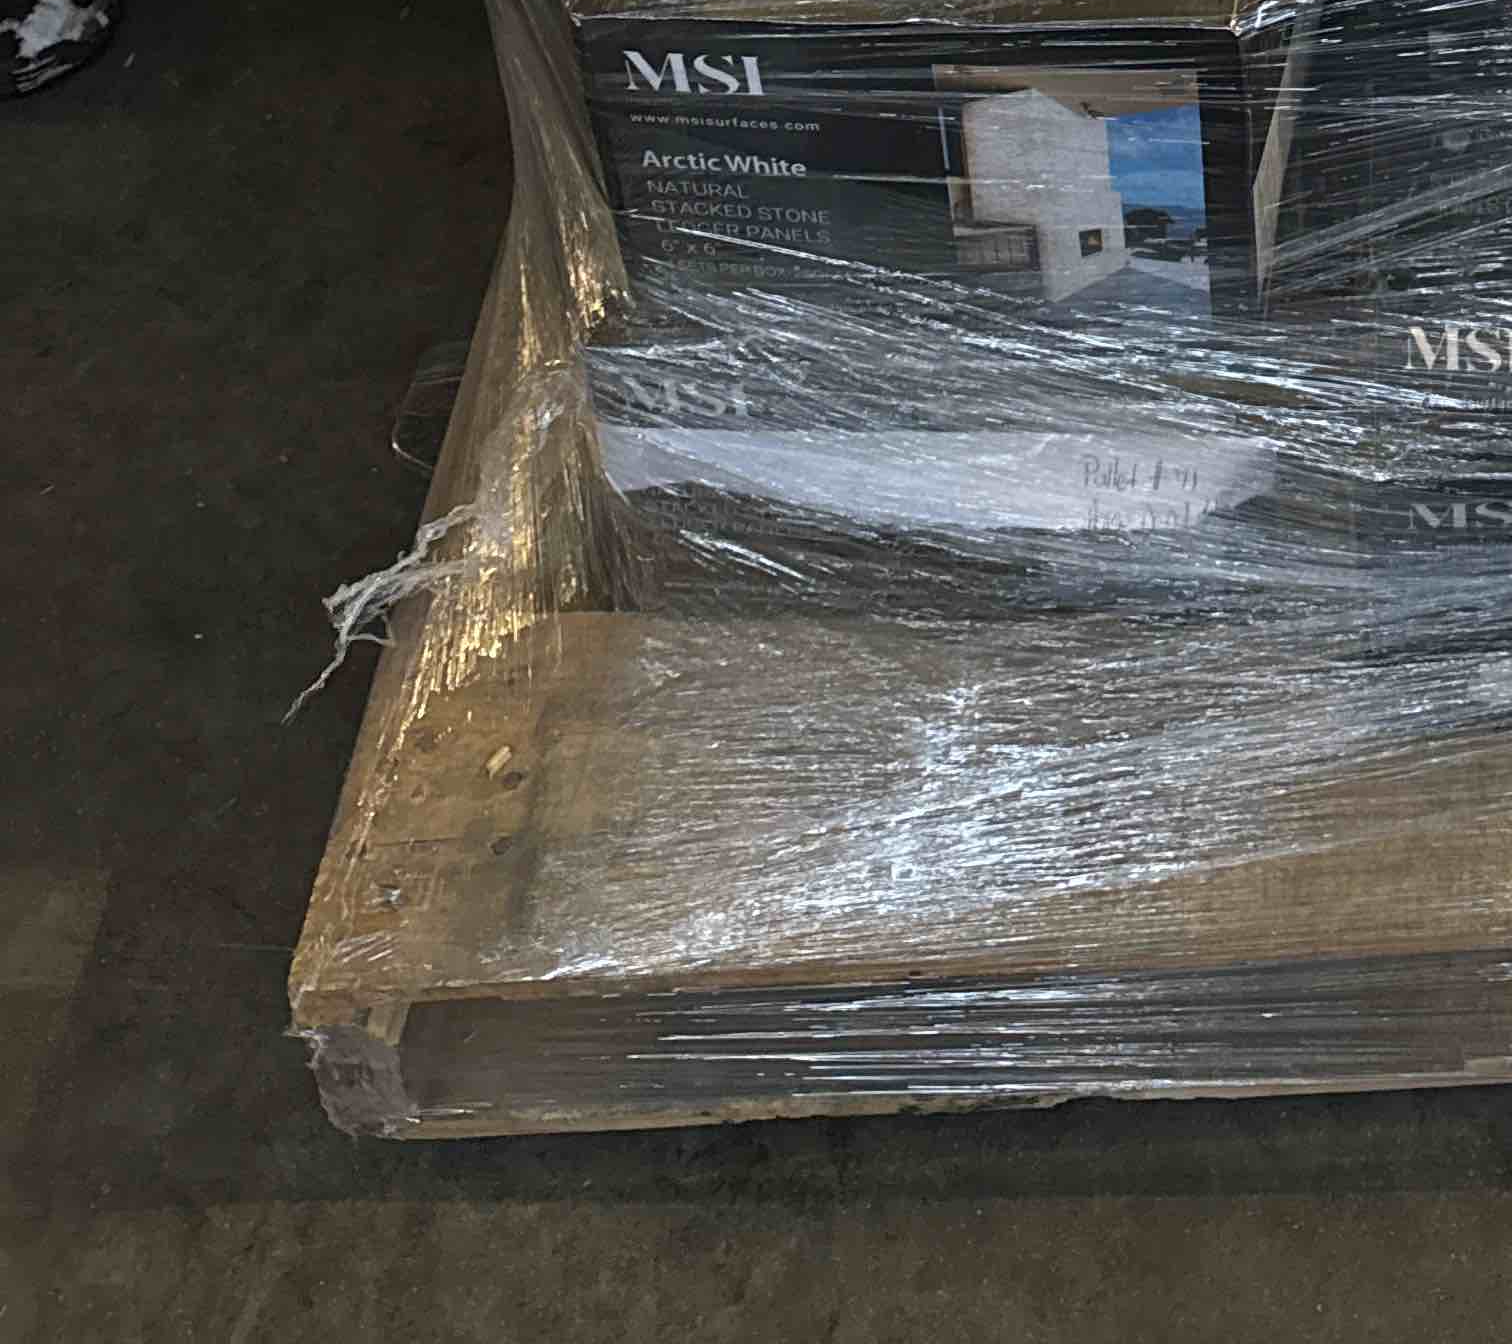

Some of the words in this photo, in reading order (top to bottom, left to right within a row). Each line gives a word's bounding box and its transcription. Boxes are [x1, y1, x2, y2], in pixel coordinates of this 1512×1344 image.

[622, 49, 766, 96] MSI
[629, 112, 820, 133] www.msisurfaces.com
[641, 149, 722, 173] Arctic
[724, 154, 808, 178] White
[646, 180, 750, 200] NATURAL
[651, 199, 752, 218] STACKED
[757, 207, 832, 226] STONE
[746, 224, 832, 244] PANELS
